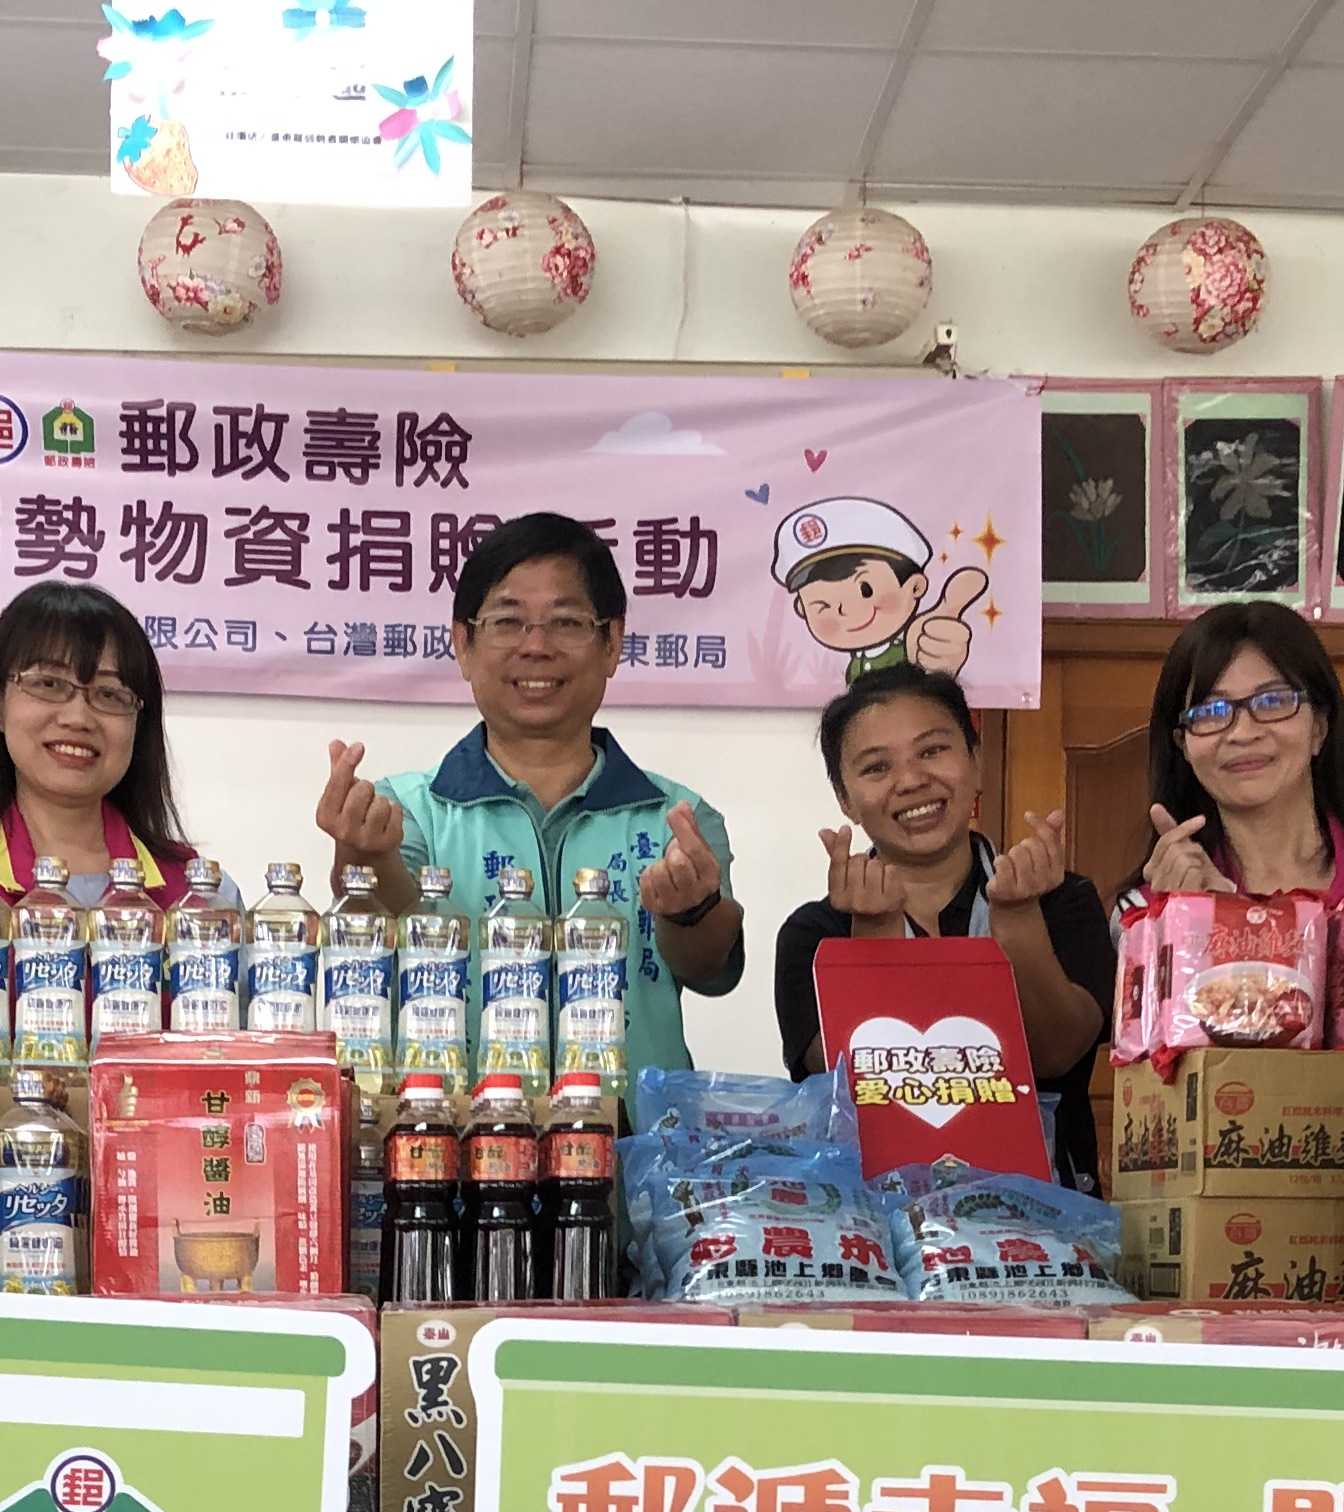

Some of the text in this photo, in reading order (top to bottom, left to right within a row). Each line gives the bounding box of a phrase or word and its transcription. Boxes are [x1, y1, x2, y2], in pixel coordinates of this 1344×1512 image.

[119, 398, 474, 490] 郵政壽險
[851, 1045, 1005, 1075] 郵政壽險
[854, 1078, 1017, 1106] 愛心捐贈
[202, 1090, 231, 1216] 甘醇醬油
[5, 1192, 70, 1219] リセッタ
[62, 1467, 104, 1508] 郵
